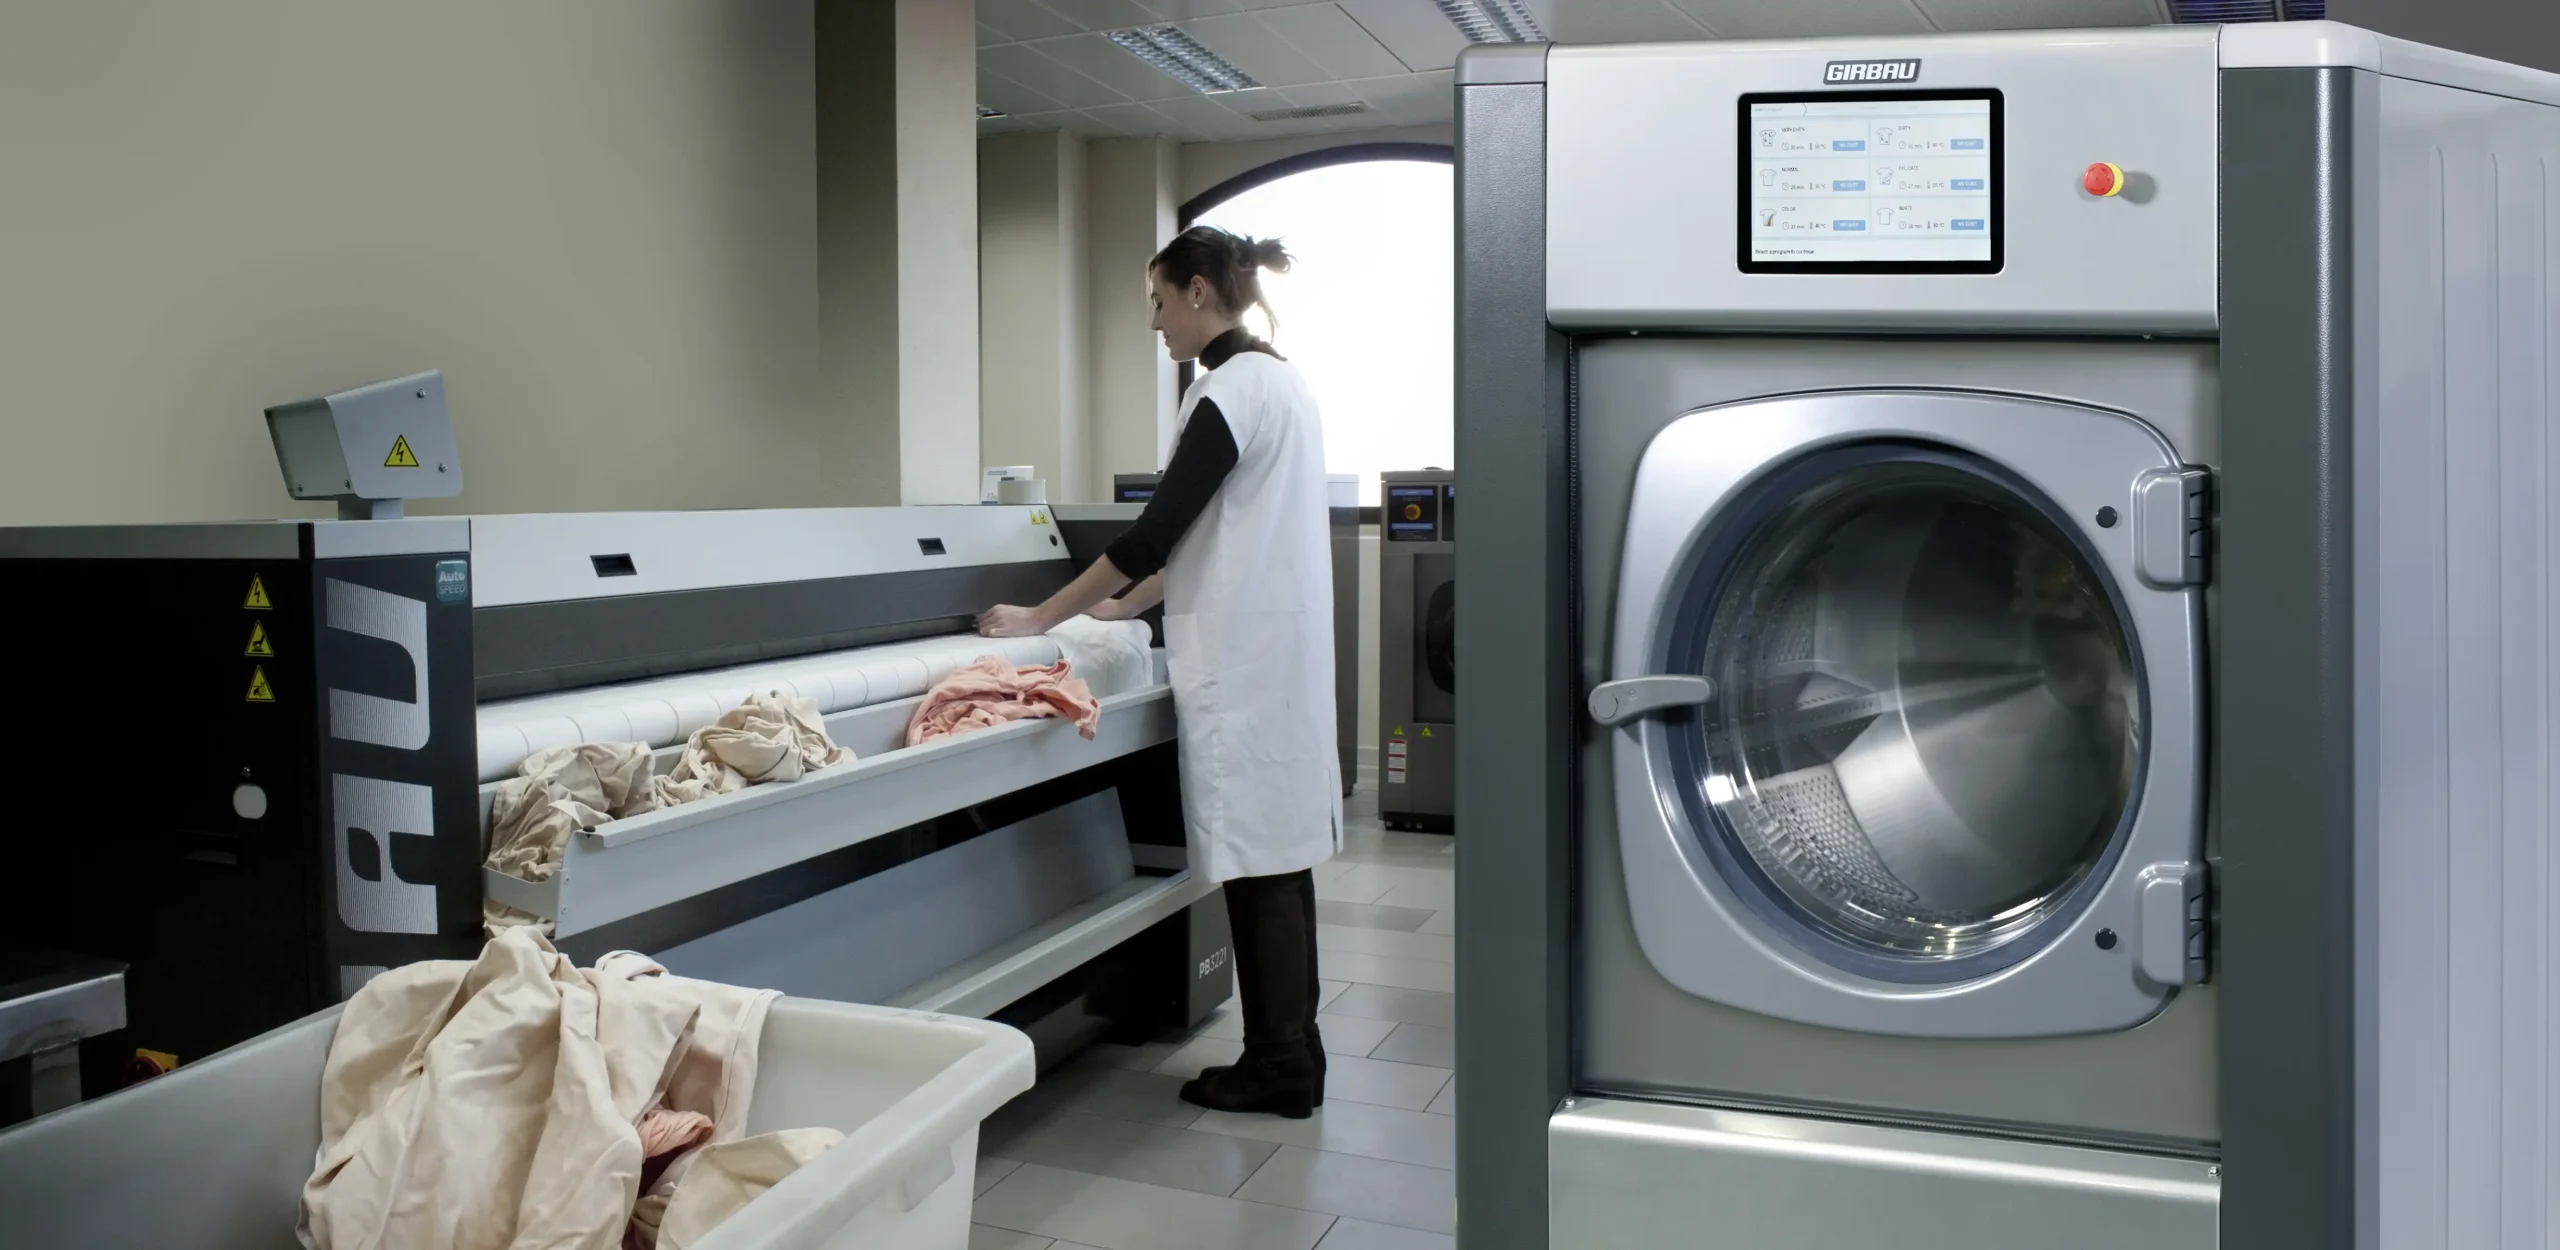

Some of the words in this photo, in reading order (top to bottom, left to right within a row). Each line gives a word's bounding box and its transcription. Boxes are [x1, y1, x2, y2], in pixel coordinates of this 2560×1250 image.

[1827, 63, 1916, 81] GIRBAU
[439, 571, 465, 582] Auto
[439, 585, 465, 595] SPEED
[326, 577, 438, 1000] AU
[1199, 946, 1227, 979] PB3221
